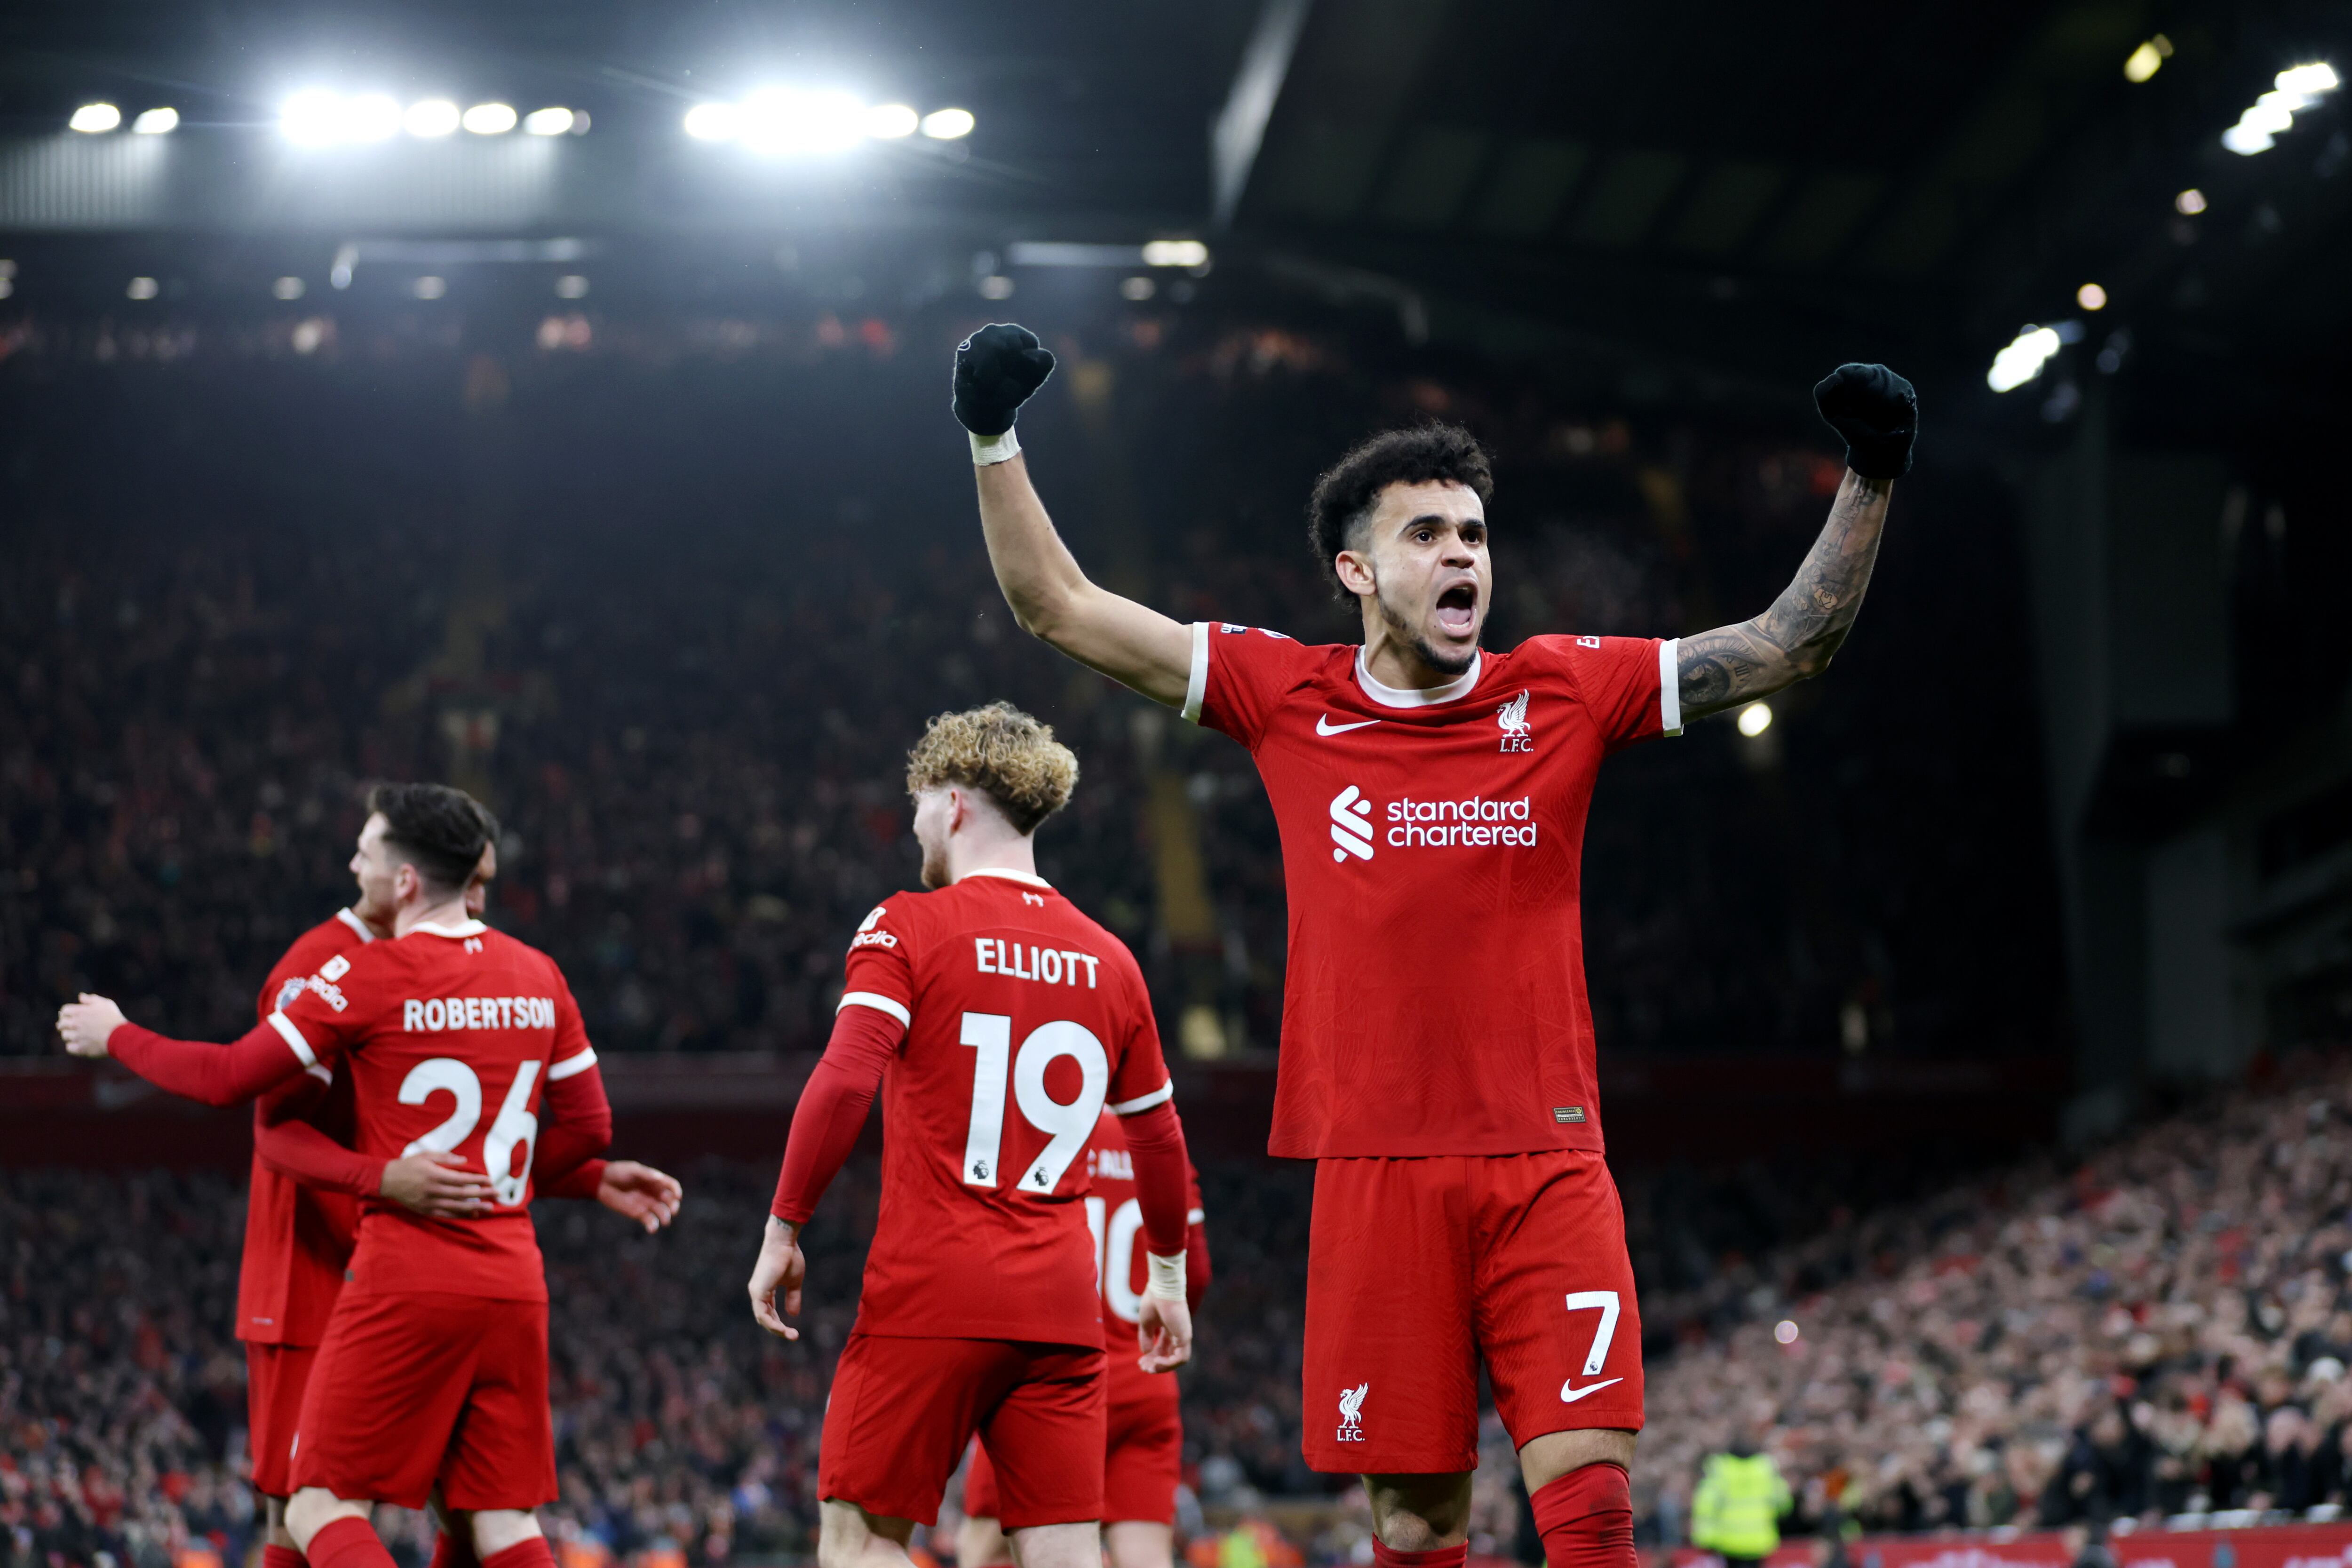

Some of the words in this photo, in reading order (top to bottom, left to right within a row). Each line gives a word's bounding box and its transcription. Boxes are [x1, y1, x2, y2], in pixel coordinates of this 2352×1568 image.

[1499, 738, 1534, 752] L.F.C.
[1387, 795, 1529, 821] standard
[1387, 821, 1536, 847] chartered
[975, 938, 1100, 989] ELLIOTT
[403, 995, 556, 1032] ROBERTSON
[960, 1011, 1109, 1195] 19
[397, 1057, 542, 1207] 26
[1565, 1290, 1621, 1376] 7
[1336, 1429, 1366, 1442] L.F.C.
